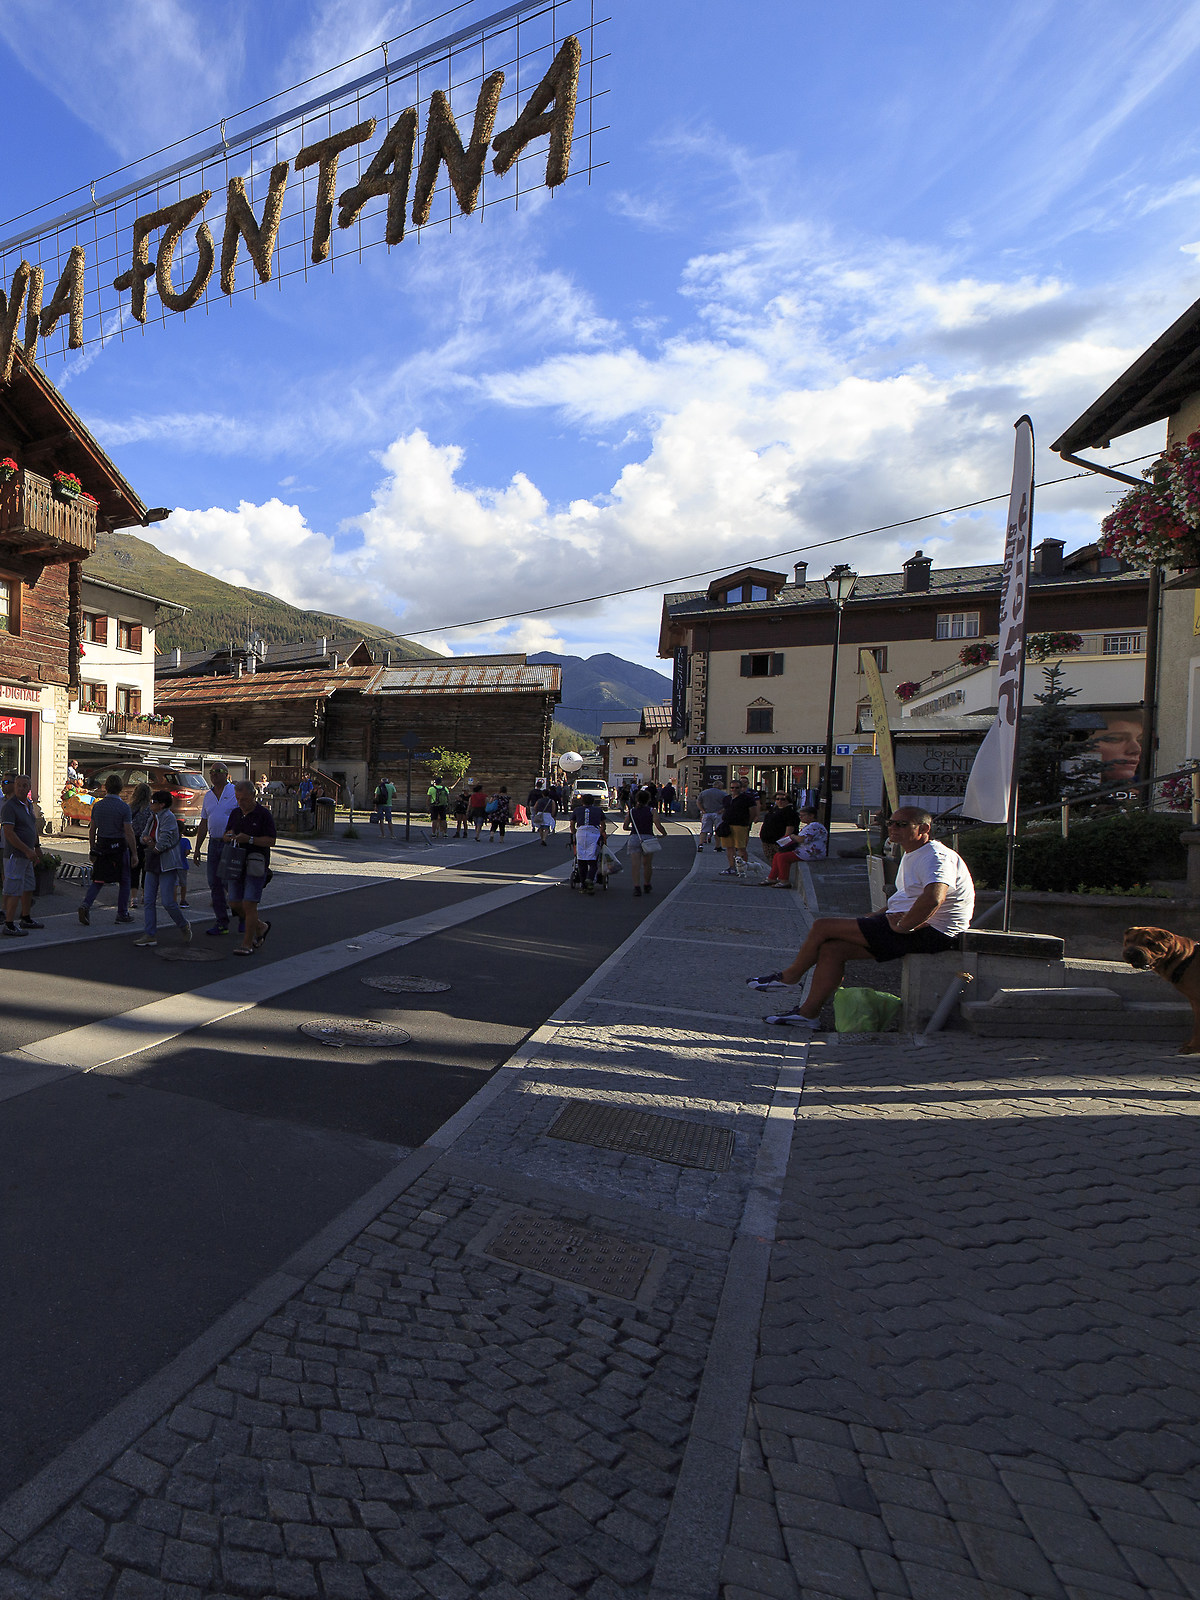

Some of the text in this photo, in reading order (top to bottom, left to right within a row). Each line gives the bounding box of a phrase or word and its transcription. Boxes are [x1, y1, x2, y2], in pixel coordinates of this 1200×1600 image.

[114, 35, 583, 324] FONTANA
[690, 744, 824, 755] EDER FASHION STORE
